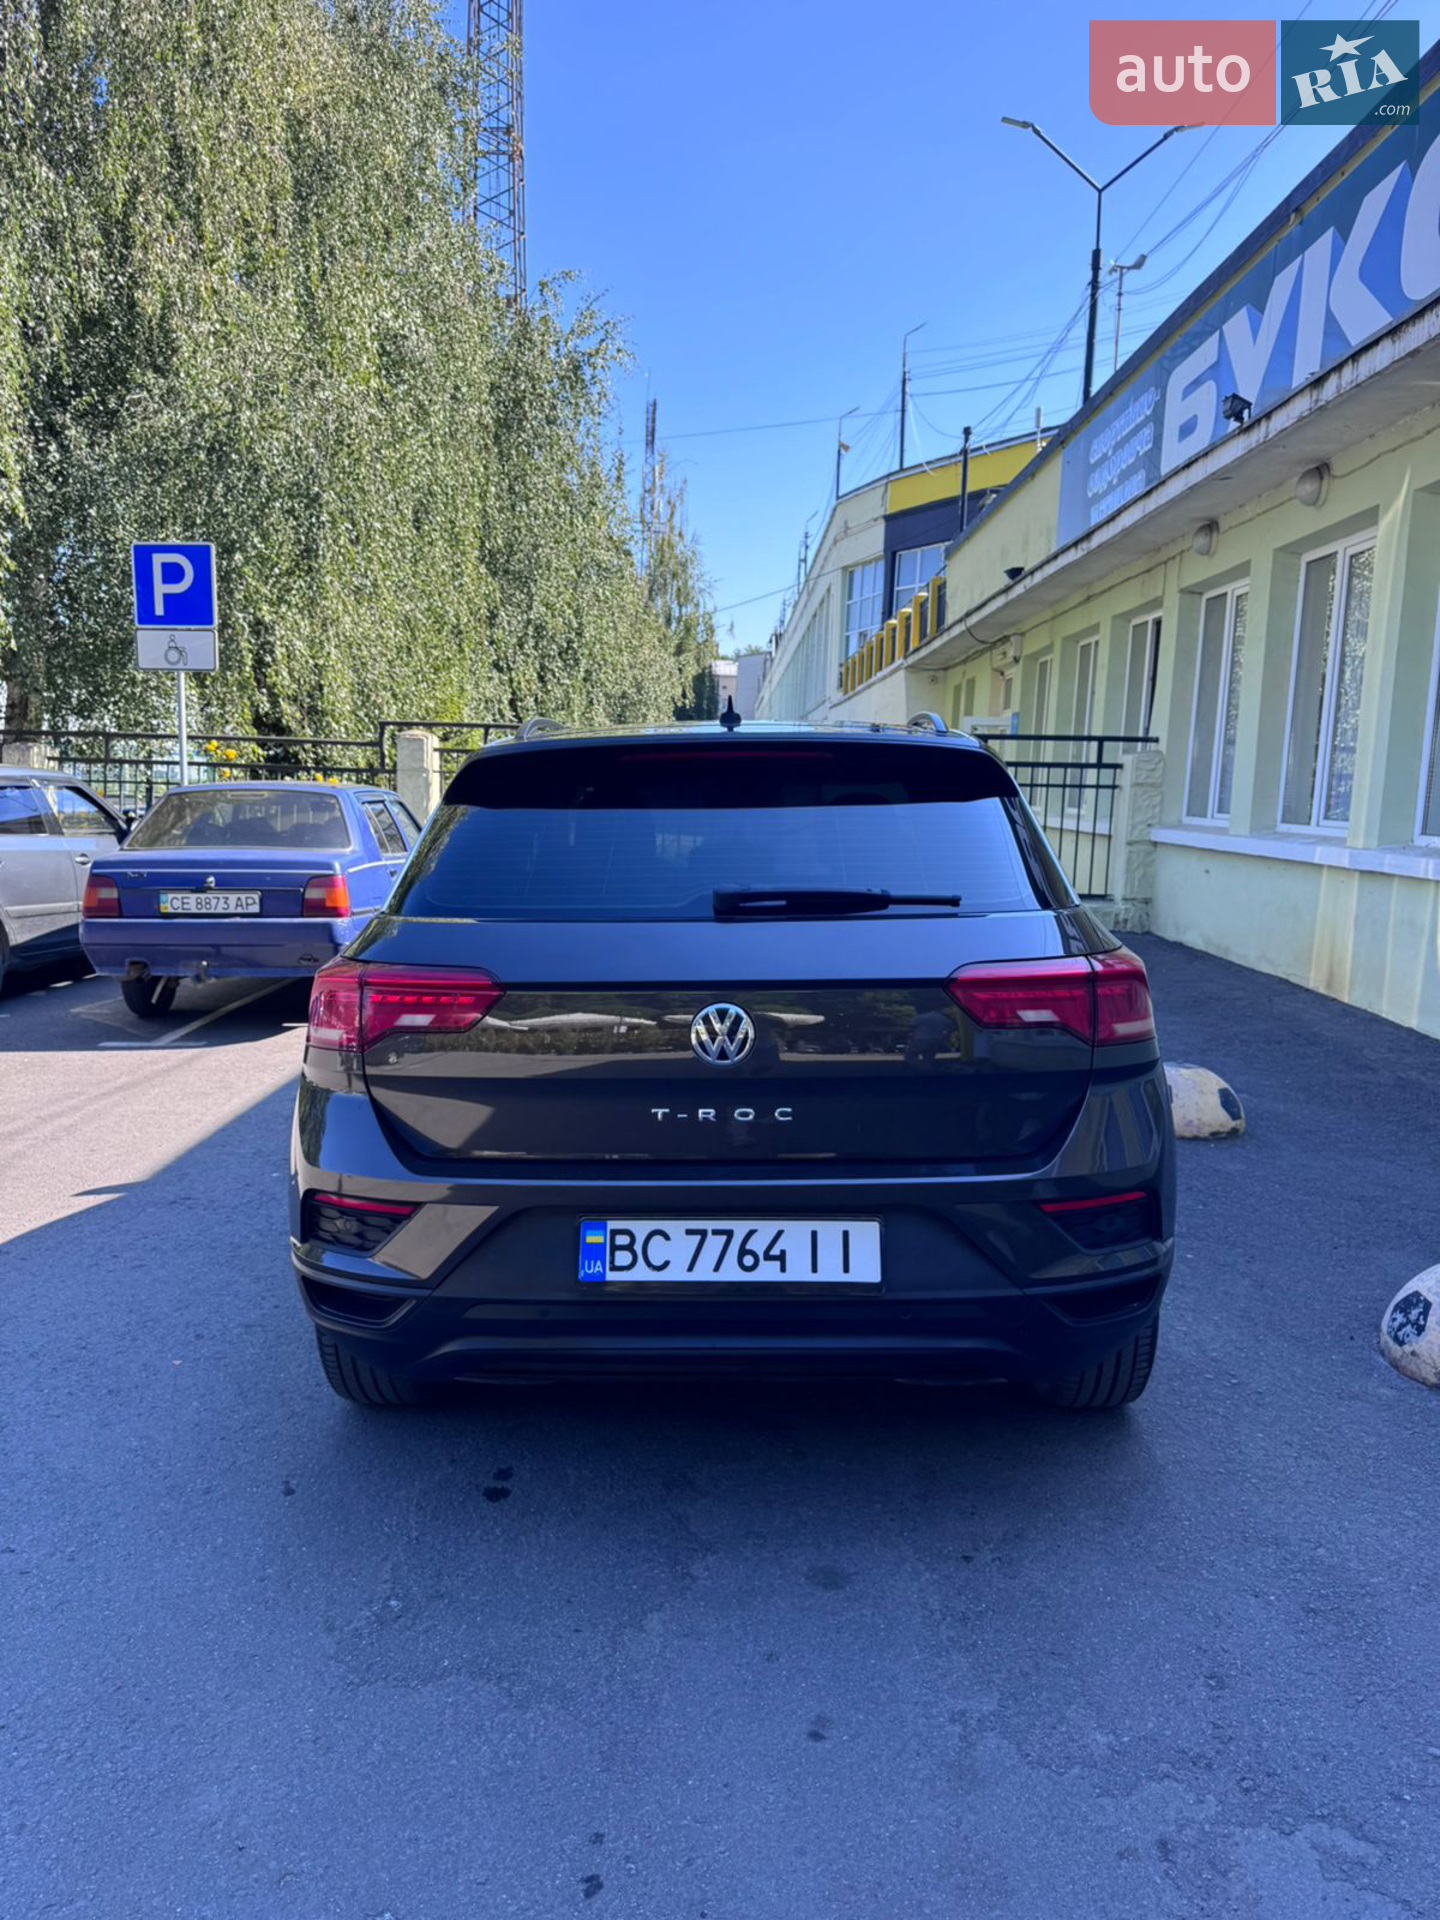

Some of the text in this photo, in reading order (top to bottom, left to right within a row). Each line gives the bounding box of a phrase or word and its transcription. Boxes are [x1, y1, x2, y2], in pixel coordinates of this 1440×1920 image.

[152, 553, 194, 617] P
[169, 896, 257, 911] CE 8873 AP
[609, 1228, 671, 1273] BC
[684, 1228, 787, 1274] 7764
[584, 1259, 604, 1274] UA
